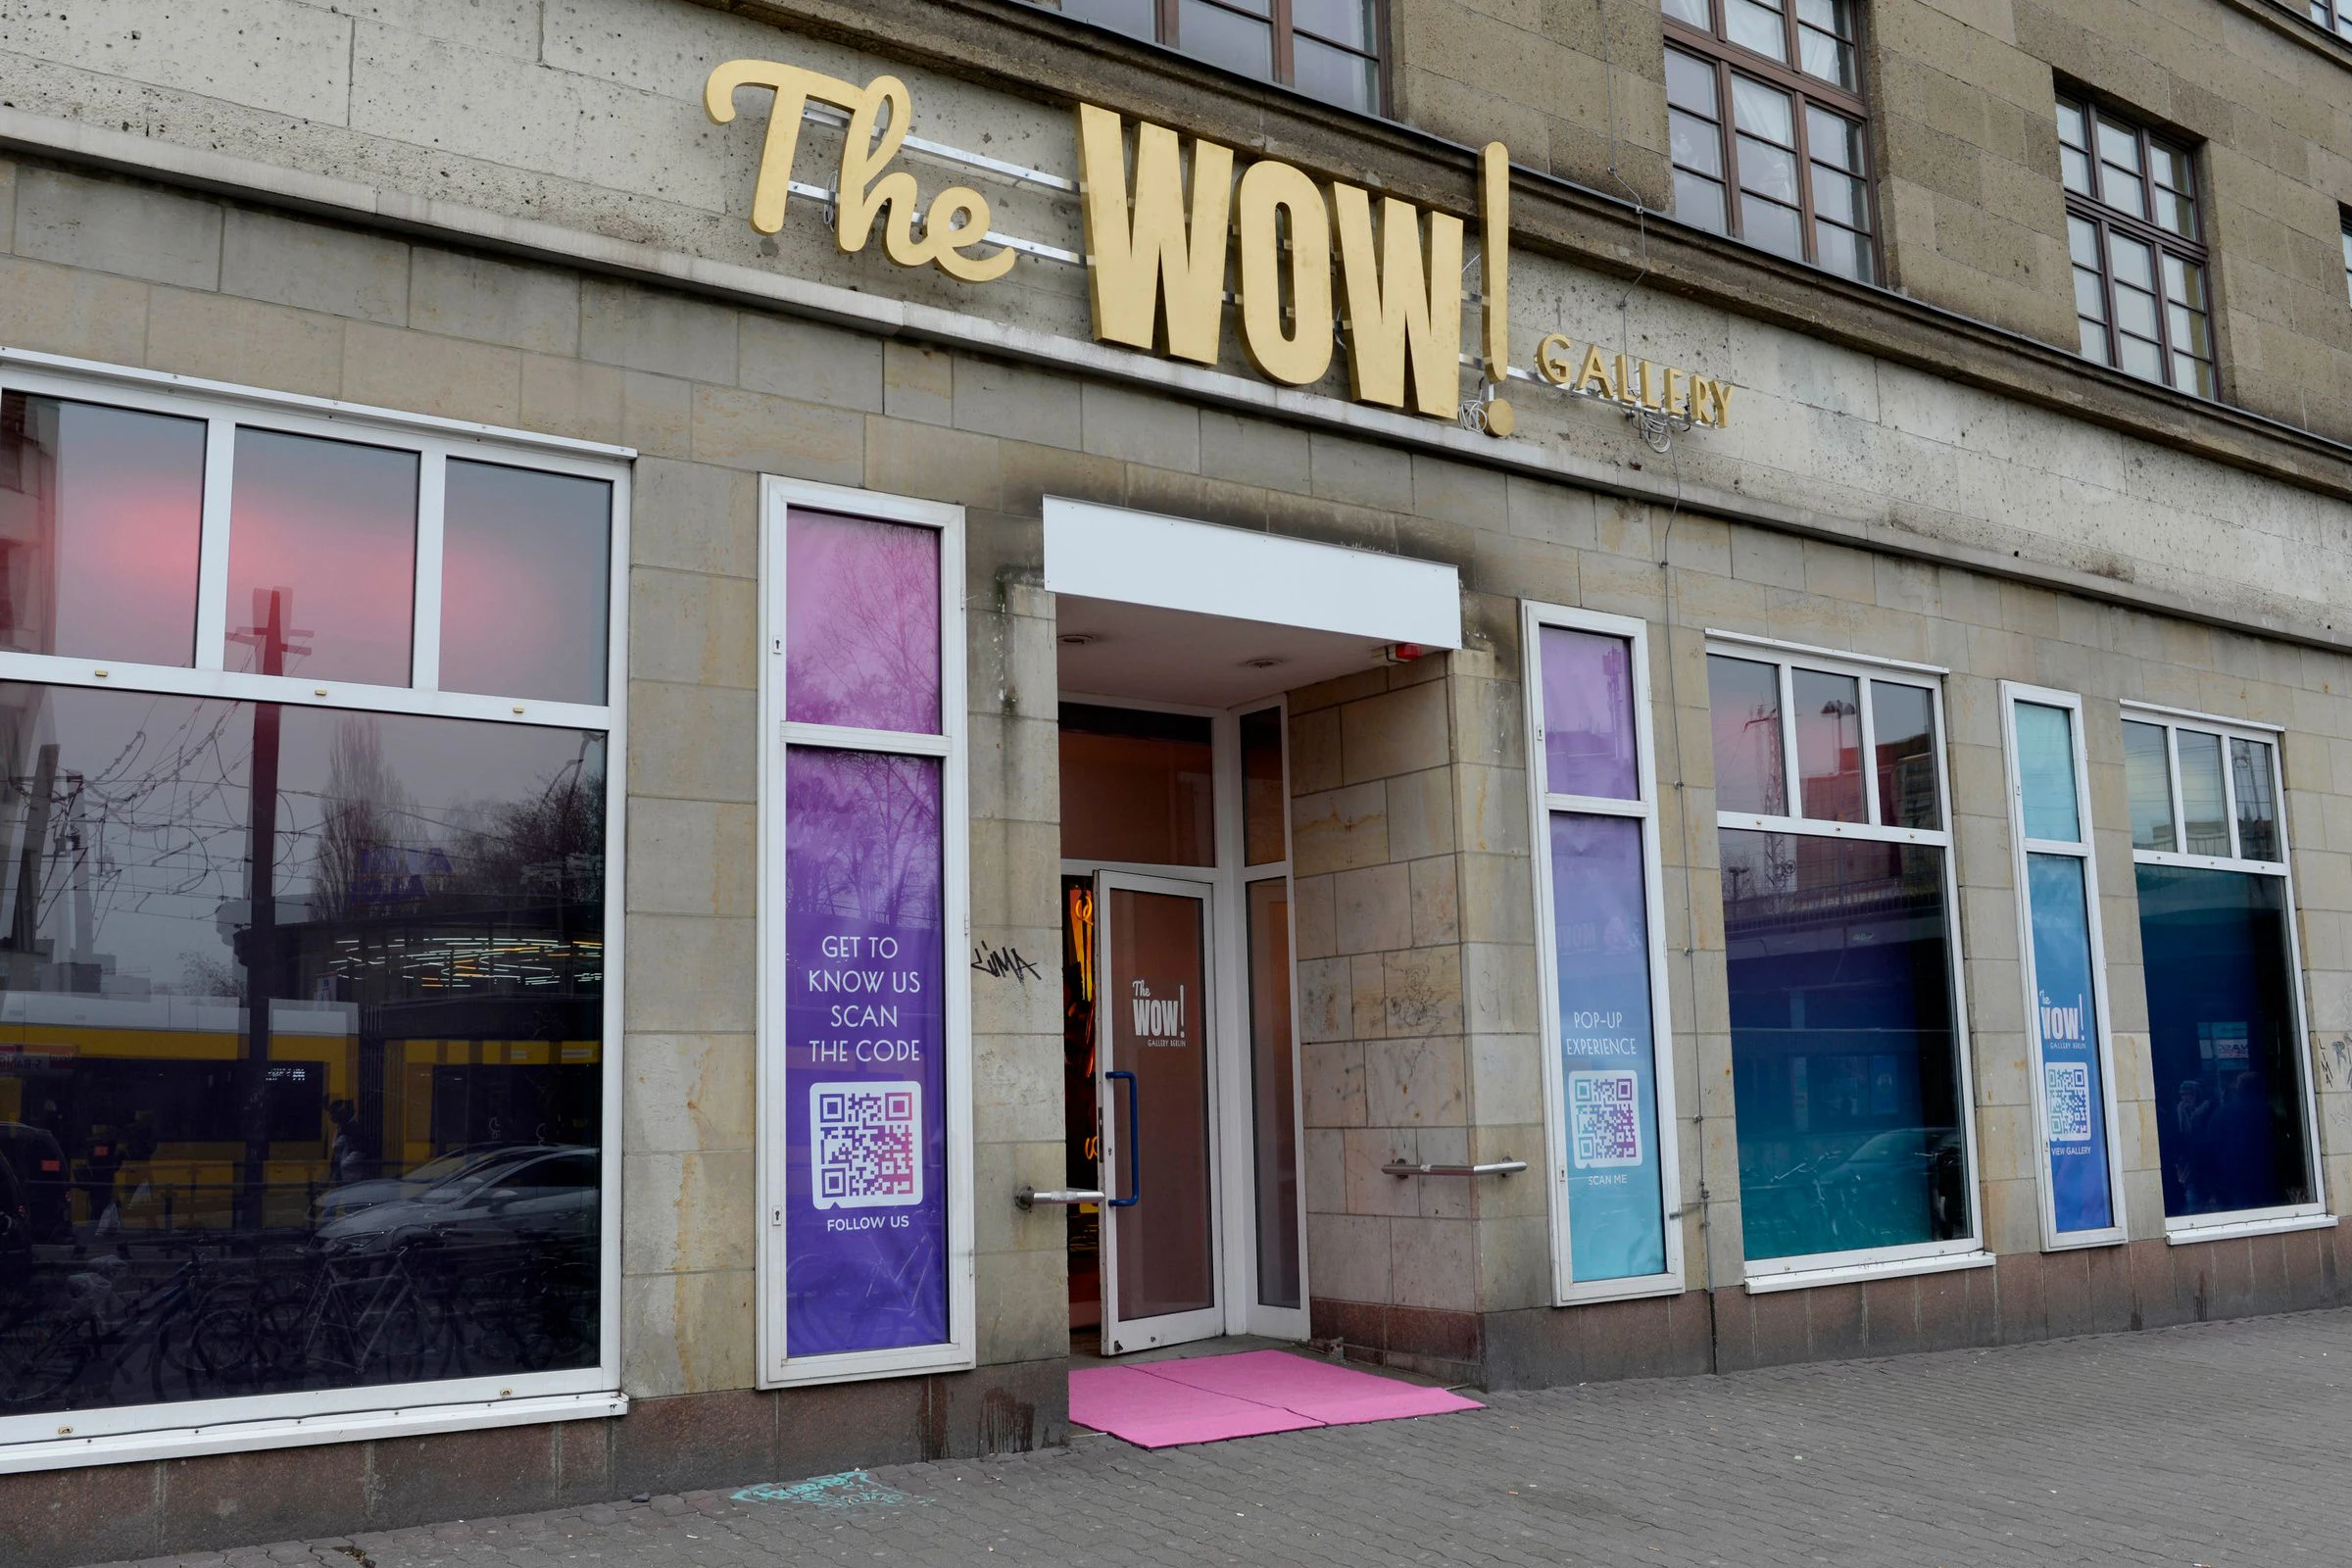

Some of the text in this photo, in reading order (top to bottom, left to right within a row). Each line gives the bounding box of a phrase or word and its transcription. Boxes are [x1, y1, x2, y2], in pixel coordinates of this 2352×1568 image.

[704, 59, 1734, 438] The WOW! GALLERY
[821, 935, 898, 959] GET TO
[808, 969, 921, 994] KNOW US
[1133, 980, 1151, 997] The
[830, 1004, 898, 1029] SCAN
[1132, 984, 1185, 1039] WOW!
[1574, 1010, 1623, 1029] POP-UP
[809, 1039, 920, 1062] THE CODE
[1566, 1038, 1638, 1055] EXPERIENCE
[2049, 1041, 2072, 1050] GALLERY
[2051, 1145, 2091, 1156] VIEW GALLERY
[1588, 1174, 1628, 1186] SCAN ME
[826, 1214, 910, 1232] FOLLOW US
